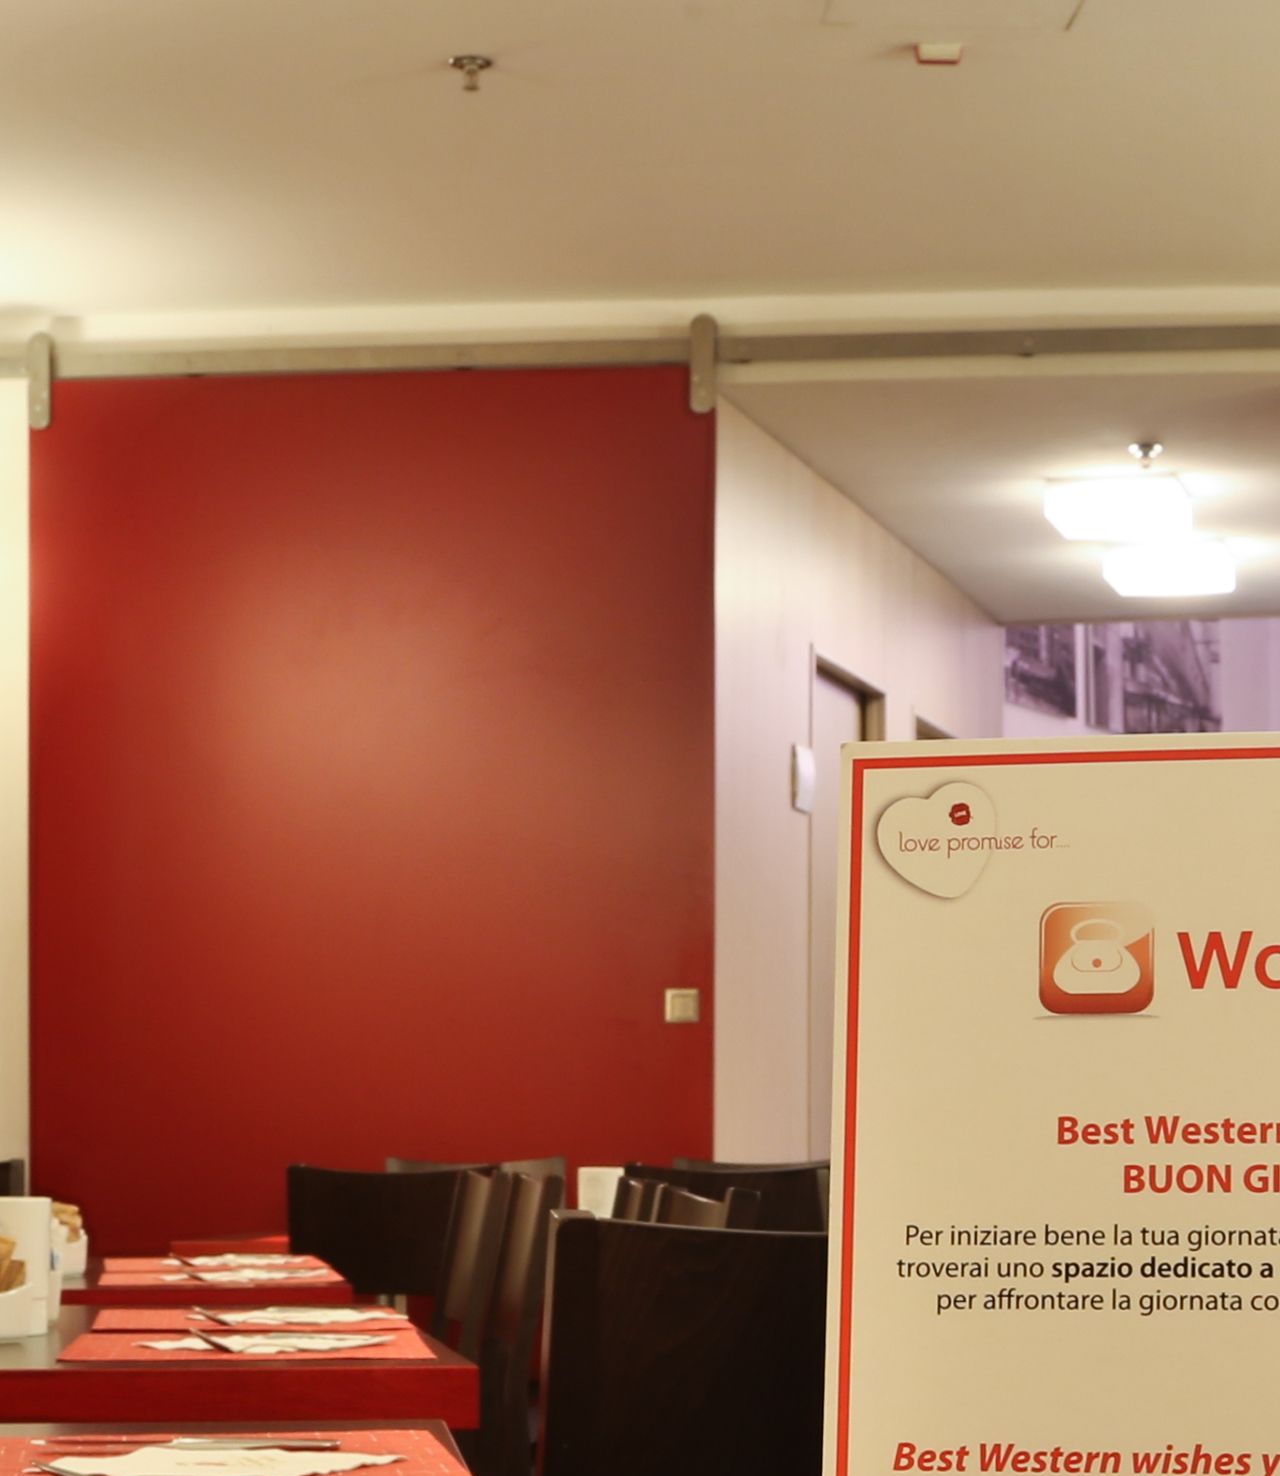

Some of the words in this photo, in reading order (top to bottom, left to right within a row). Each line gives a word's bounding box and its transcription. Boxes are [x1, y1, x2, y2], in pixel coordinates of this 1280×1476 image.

[898, 831, 941, 852] love
[947, 834, 1024, 859] promise
[1057, 1116, 1135, 1145] Best
[1124, 1164, 1231, 1193] BUON
[906, 1225, 943, 1246] Per
[951, 1225, 1037, 1246] iniziare
[1045, 1224, 1105, 1246] bene
[1114, 1224, 1132, 1246] la
[1140, 1227, 1179, 1246] tua
[897, 1257, 989, 1278] troverai
[997, 1262, 1044, 1278] uno
[1051, 1256, 1133, 1283] spazio
[1140, 1256, 1253, 1278] dedicato
[1259, 1262, 1274, 1278] a
[937, 1294, 977, 1315] per
[983, 1288, 1104, 1310] affrontare
[1112, 1288, 1131, 1310] la
[1139, 1289, 1242, 1316] giornata
[893, 1442, 970, 1472] Best
[980, 1443, 1121, 1473] Western
[1132, 1444, 1252, 1475] wishes
